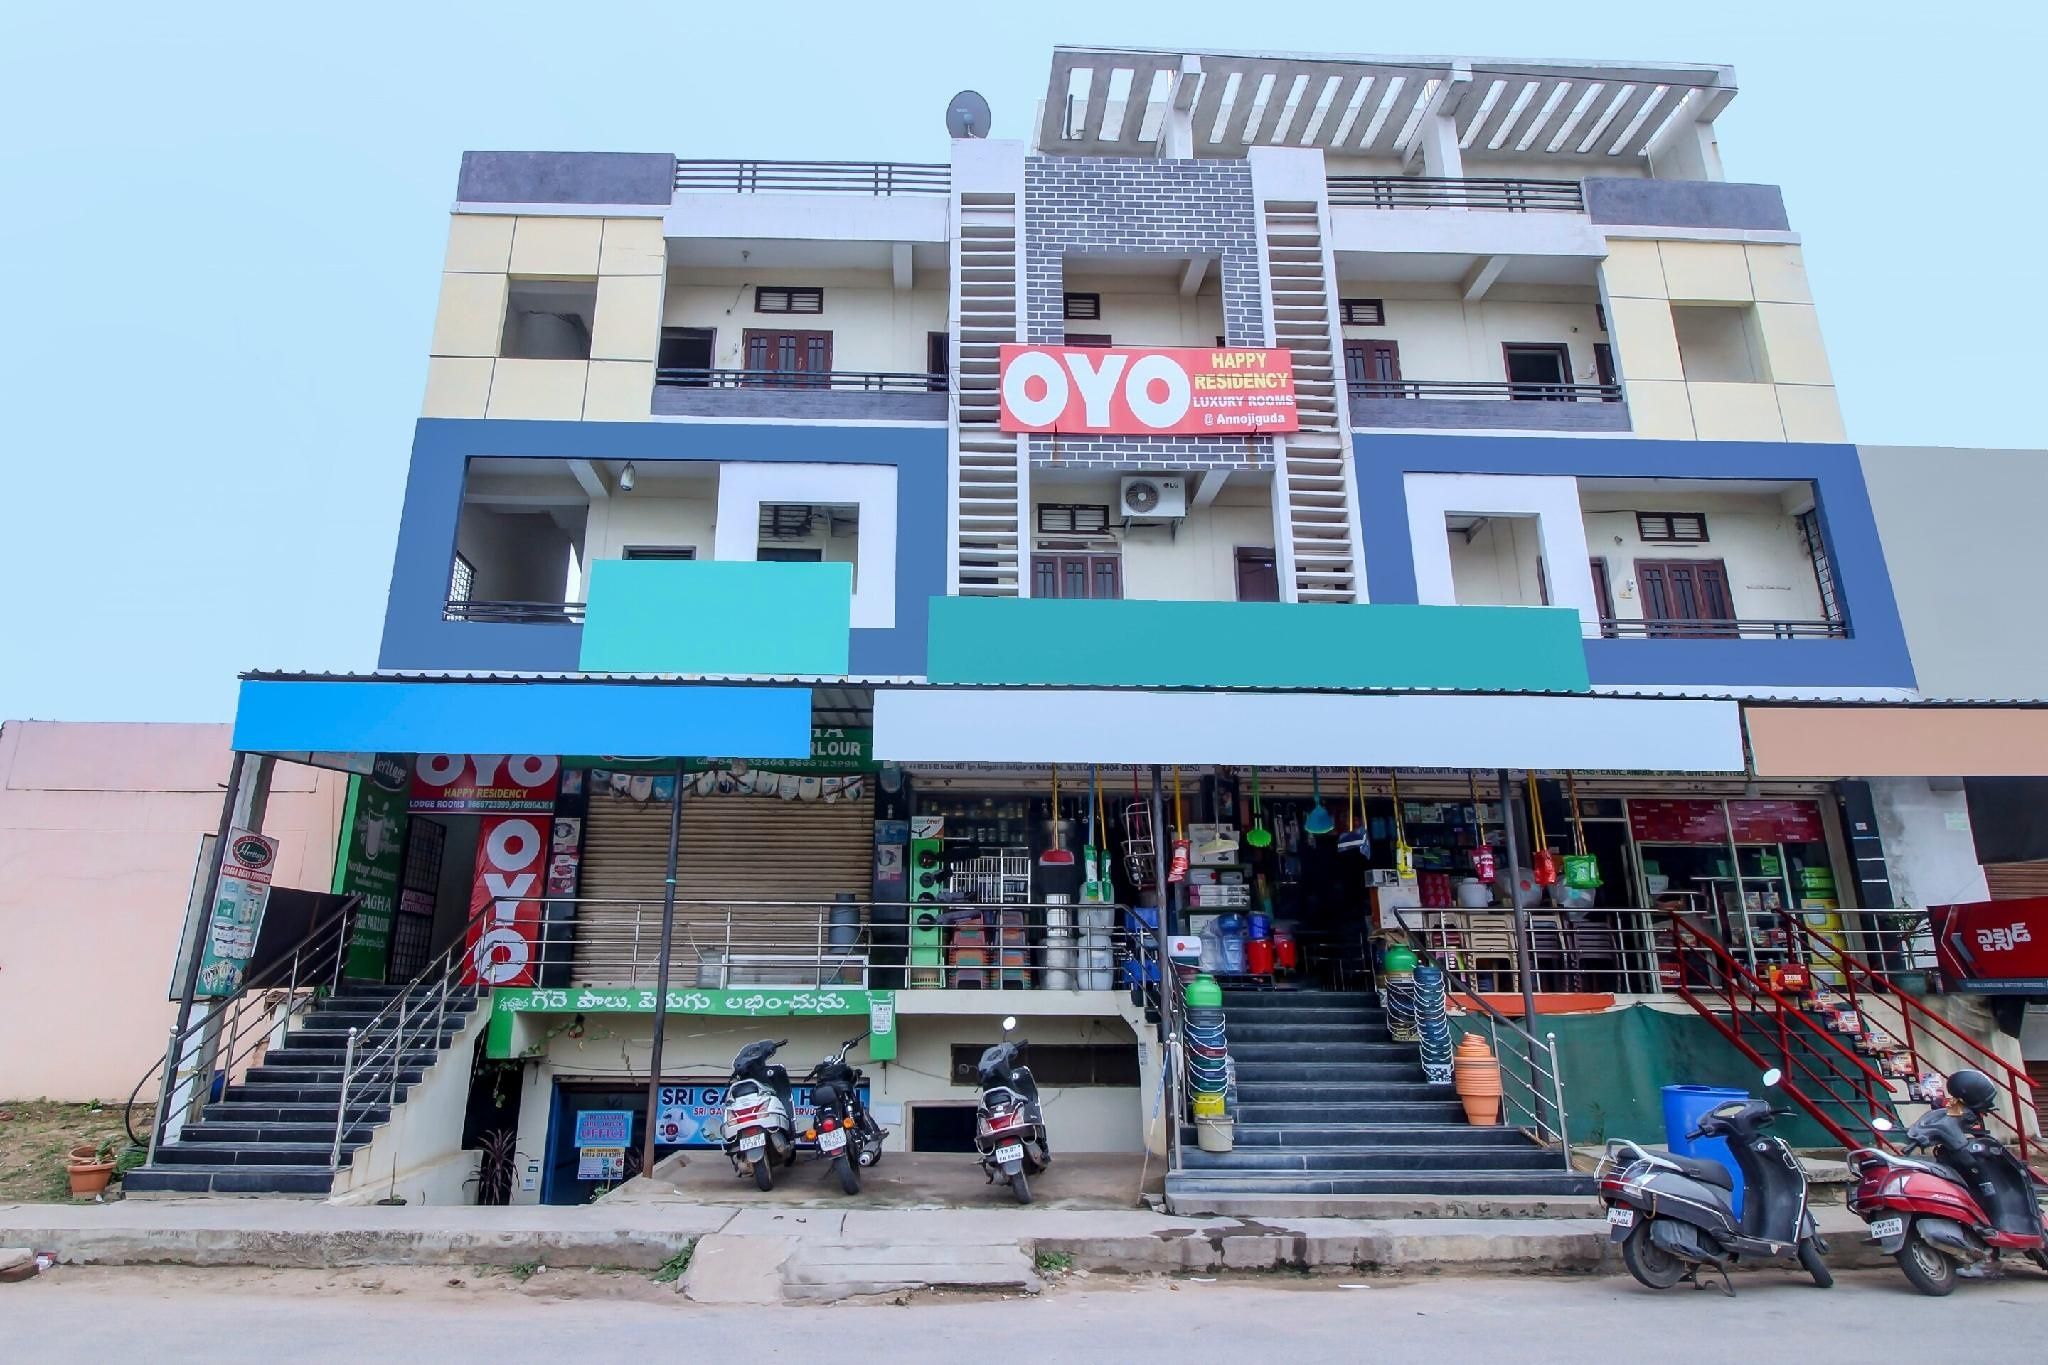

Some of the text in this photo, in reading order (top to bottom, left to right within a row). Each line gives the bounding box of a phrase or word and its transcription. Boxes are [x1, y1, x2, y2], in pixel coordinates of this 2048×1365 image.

[1211, 352, 1267, 369] HAPPY
[1002, 351, 1191, 428] OYO
[1194, 372, 1289, 390] RESIDENCY
[1193, 395, 1295, 408] LUXURY ROOMS
[1204, 412, 1286, 428] @ Annojiguda
[416, 753, 559, 788] OYO
[444, 788, 529, 798] HAPPY RESIDENCY
[409, 800, 435, 808] LODGE
[436, 800, 465, 809] ROOMS
[474, 819, 541, 983] OYO
[662, 1088, 693, 1105] SRI
